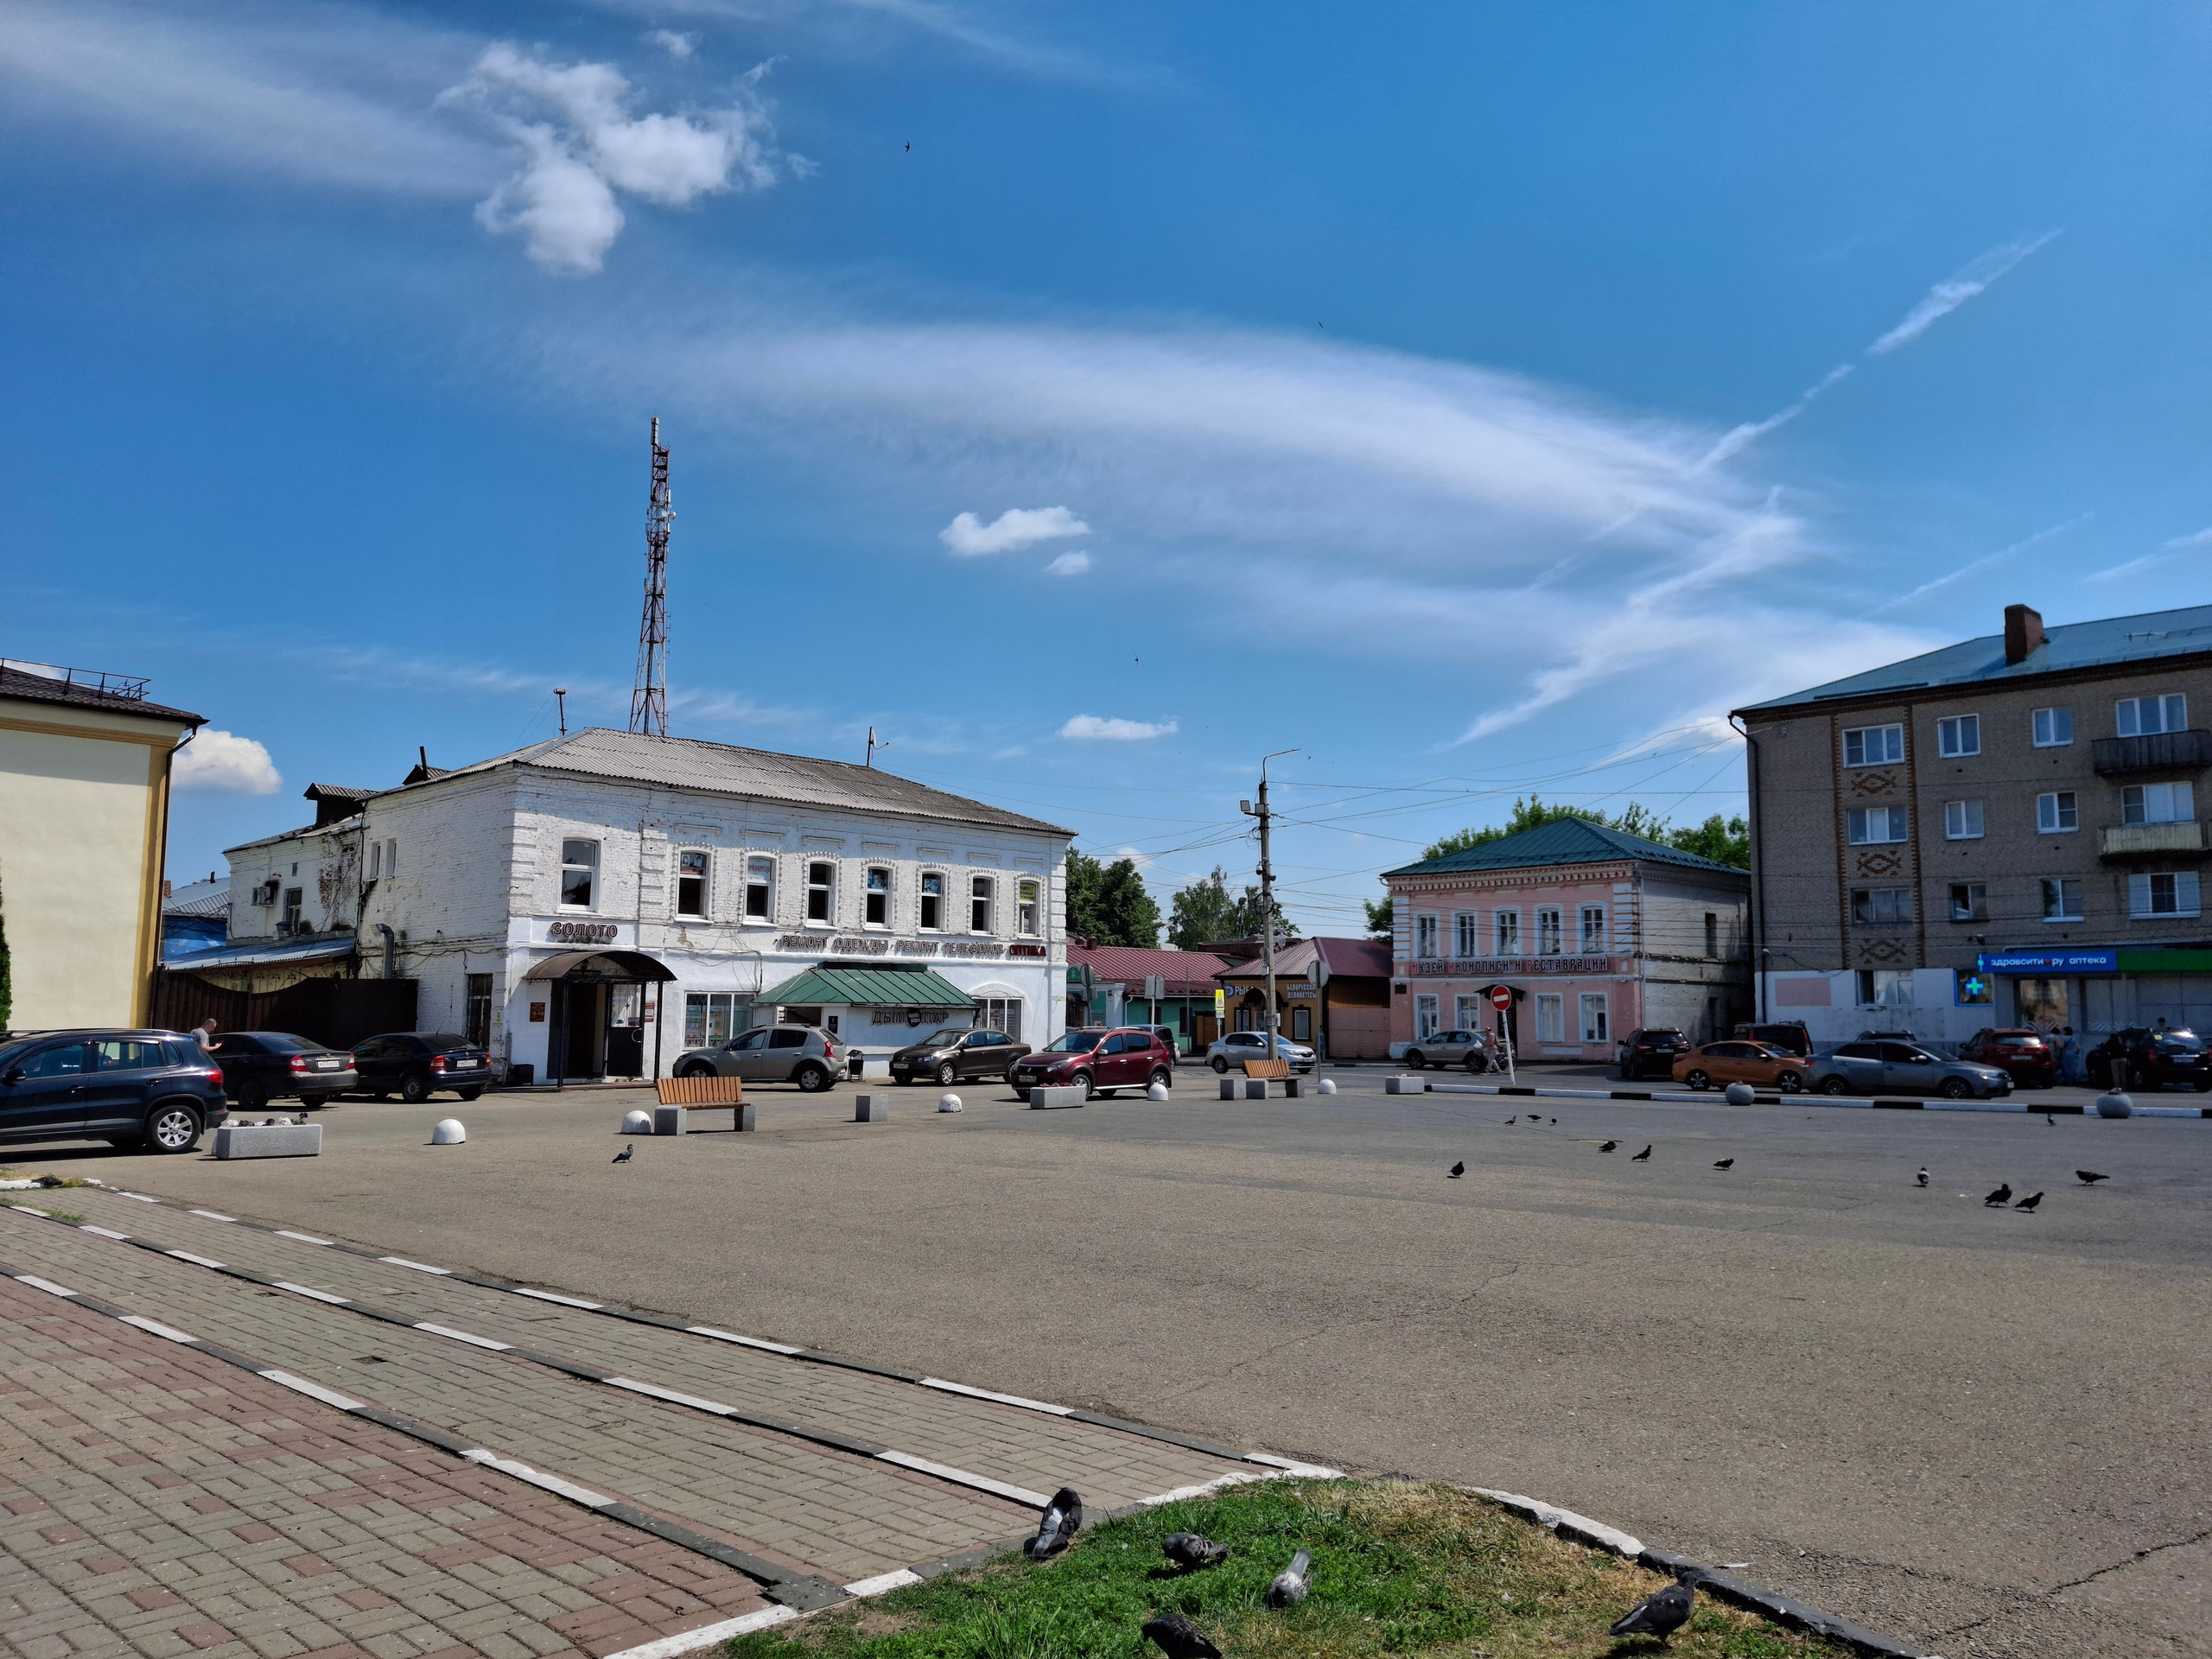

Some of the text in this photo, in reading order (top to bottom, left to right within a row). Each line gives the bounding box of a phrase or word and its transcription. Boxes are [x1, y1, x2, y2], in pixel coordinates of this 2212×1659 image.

[551, 922, 618, 938] ЗОЛОТО
[781, 935, 889, 953] РЕМОНТ ОДЕЖДЫ
[896, 939, 1005, 956] РЕМОНТ ТЕЛЕФОНОВ
[1448, 960, 1509, 973] ИКОНОПИСИ
[1527, 957, 1607, 972] РЕСТАВРАЦИИ
[2069, 957, 2107, 965] аптека
[1235, 985, 1254, 995] РЫБ
[873, 1012, 950, 1026] ДЫМ ПАР
